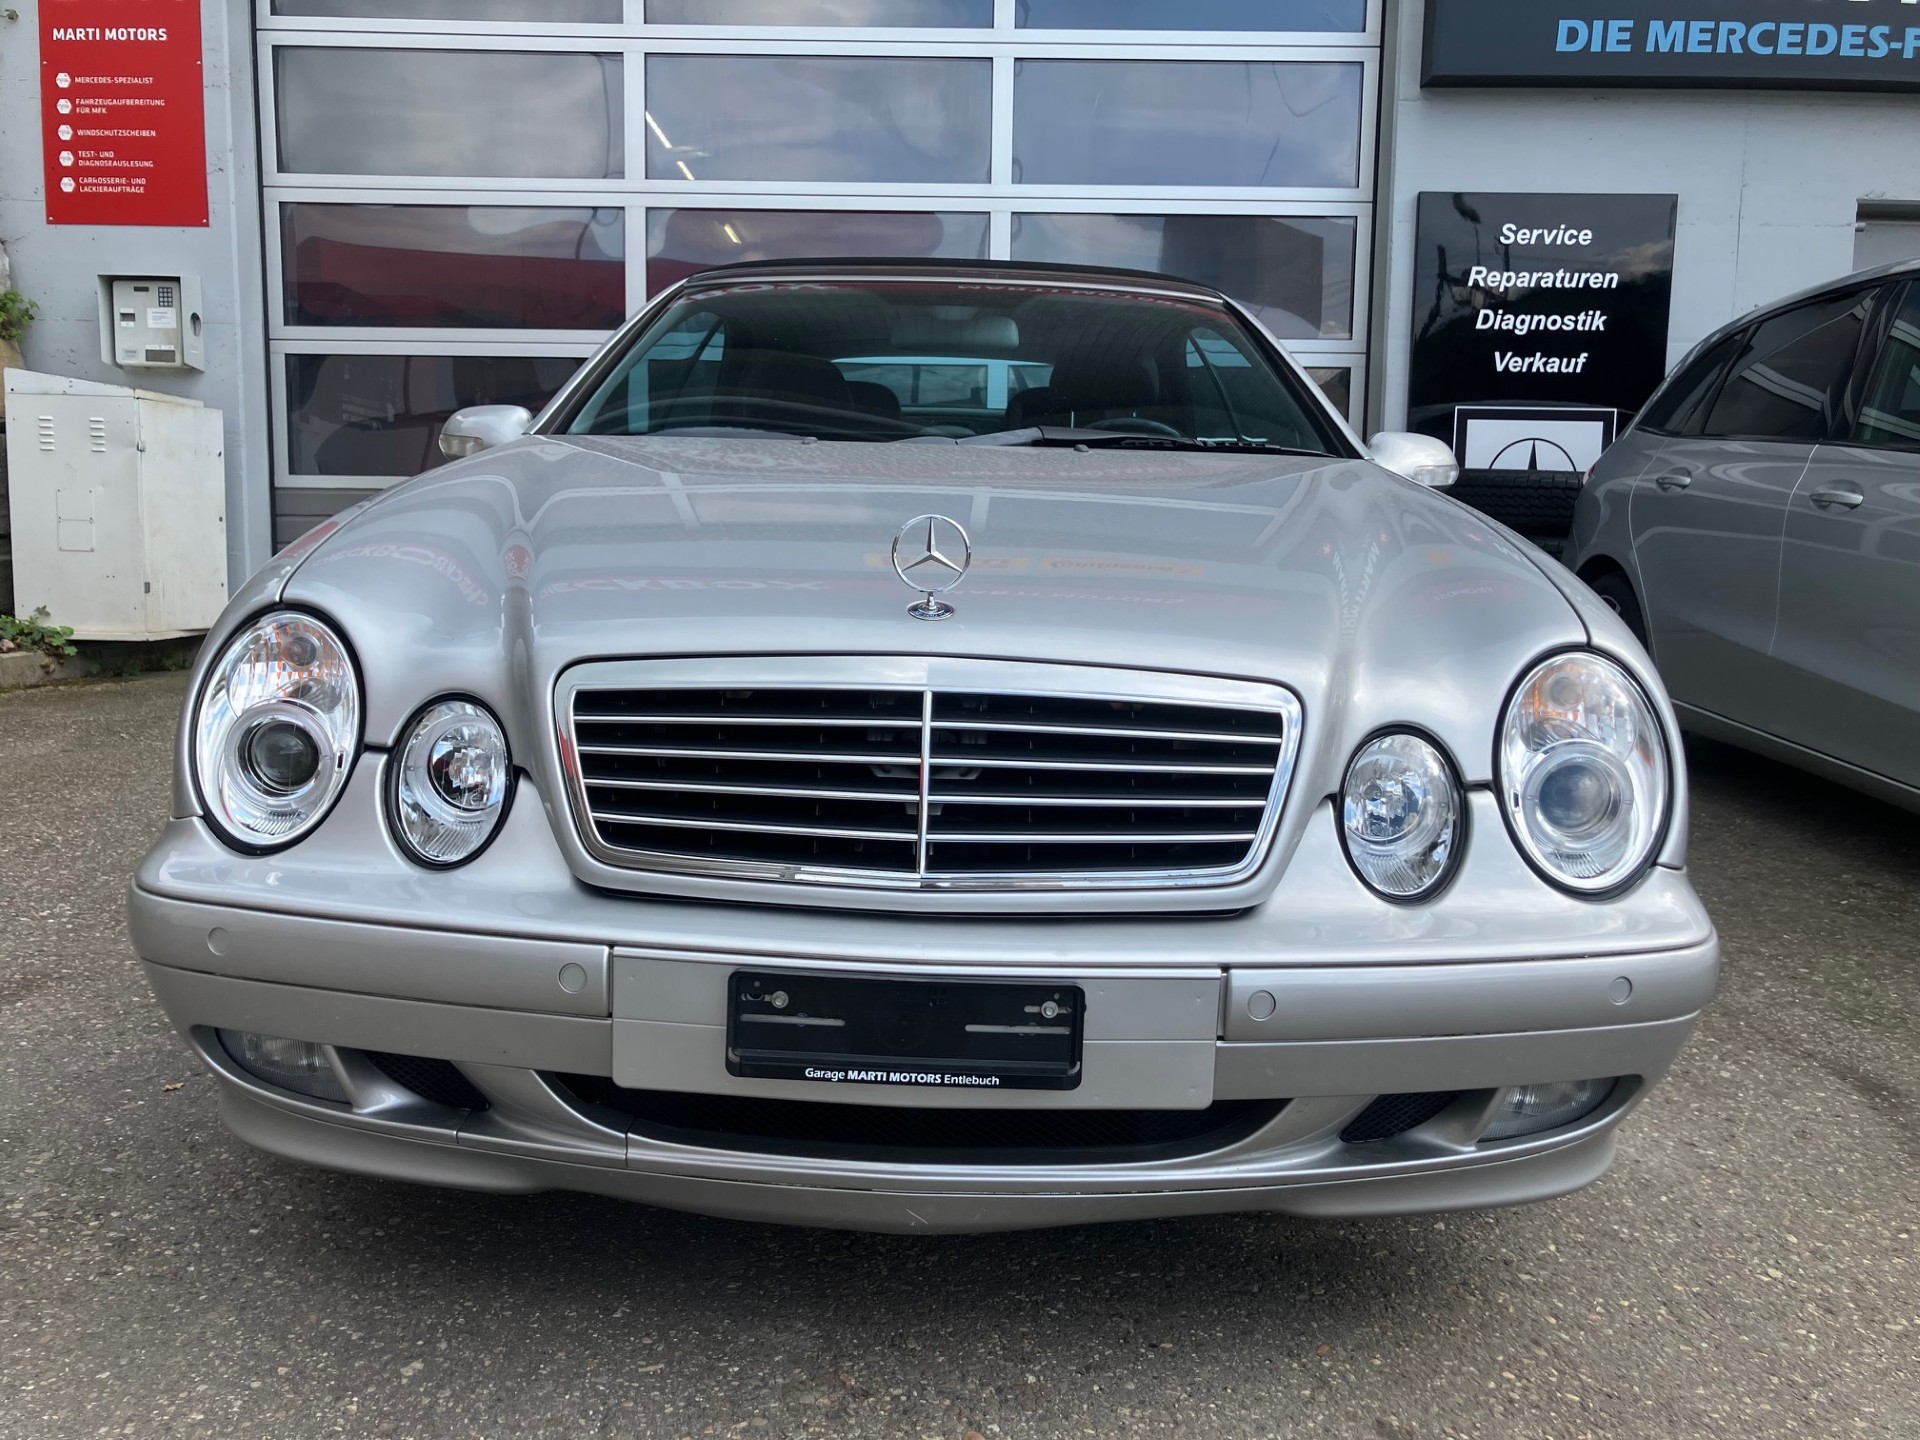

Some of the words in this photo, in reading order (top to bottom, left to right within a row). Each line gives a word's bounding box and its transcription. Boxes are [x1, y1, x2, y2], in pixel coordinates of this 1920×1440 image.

[52, 28, 101, 41] MARTI
[104, 28, 168, 41] MOTORS
[1555, 19, 1634, 53] DIE
[74, 76, 154, 85] MERCEDES-SPEZIALIST
[75, 98, 166, 106] FAHRZEUGAUFBEREITUNG
[76, 106, 91, 114] FÜR
[77, 129, 156, 137] WINDSCHUTZSCHEIBEN
[78, 150, 98, 158] TEST-
[78, 160, 154, 168] DIAGNOSEAUSLESUNG
[130, 177, 147, 185] UND
[79, 185, 145, 194] LACKIERAUFTRÄGE
[1499, 223, 1593, 246] Service
[1467, 266, 1620, 293] Reparaturen
[1475, 308, 1608, 336] Diagnostik
[1494, 351, 1589, 374] Verkauf
[804, 1067, 846, 1082] Garage
[846, 1070, 888, 1082] MARTI
[888, 1072, 942, 1084] MOTORS
[943, 1074, 1000, 1086] Entlebuch
